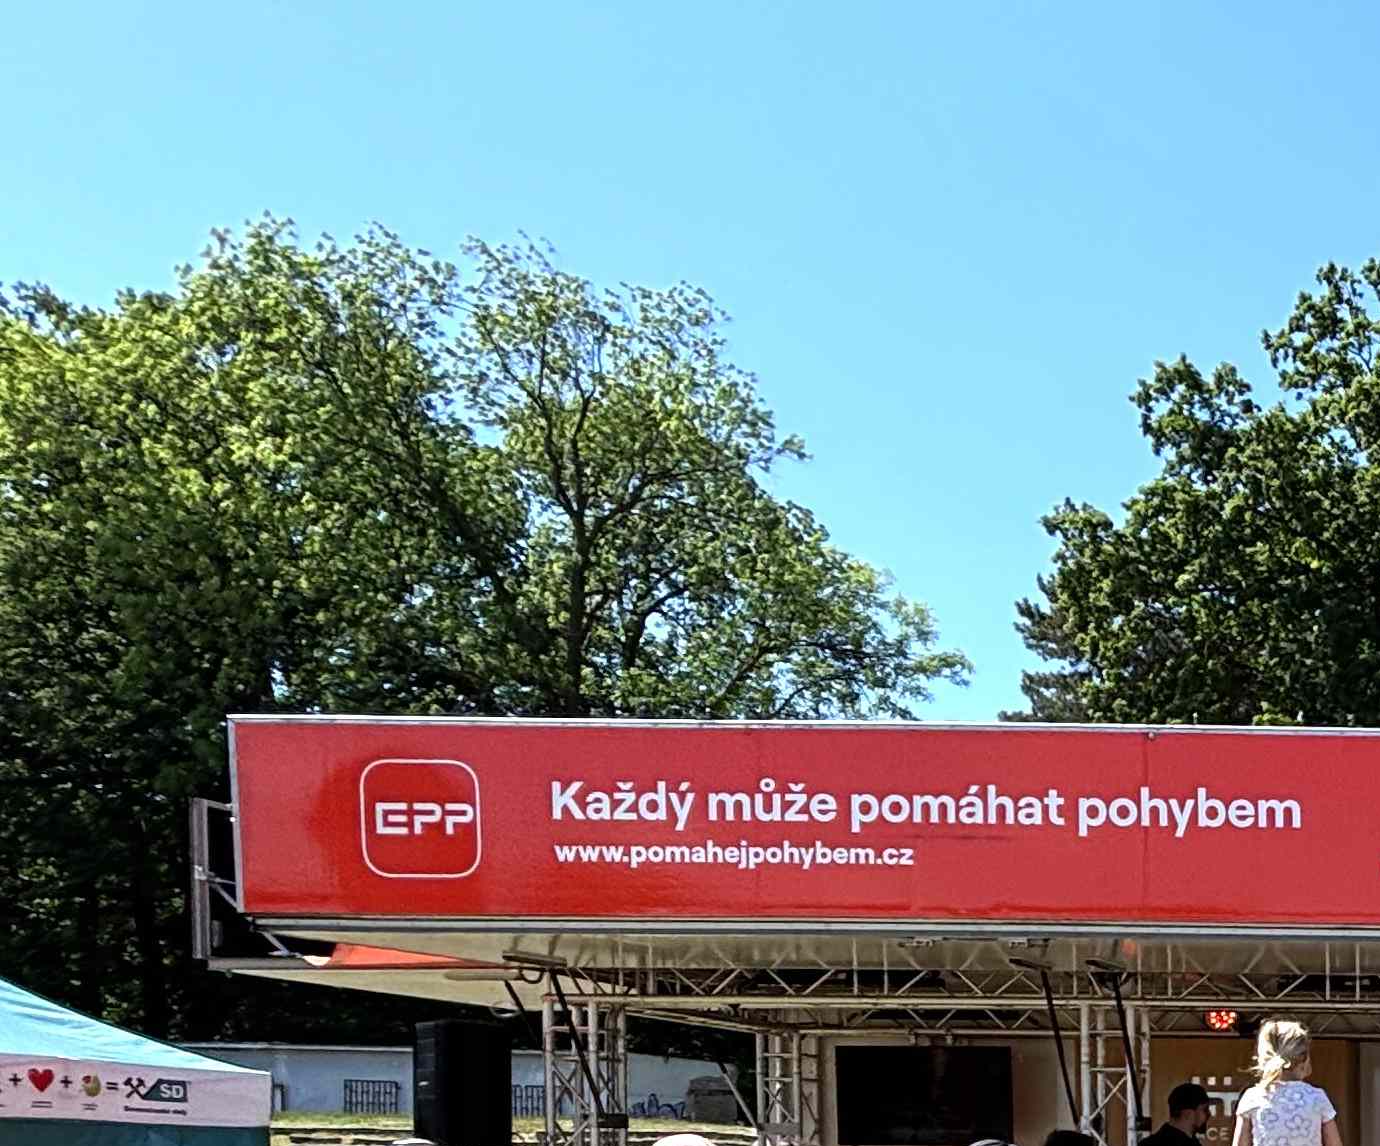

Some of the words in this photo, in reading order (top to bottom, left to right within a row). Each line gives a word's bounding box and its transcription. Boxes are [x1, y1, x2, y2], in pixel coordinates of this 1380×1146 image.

[375, 802, 474, 835] EPP
[551, 780, 694, 831] Každý
[708, 777, 838, 822] může
[850, 784, 1065, 833] pomáhat
[1078, 786, 1302, 838] pohybem
[554, 839, 914, 870] www.pomahejpohybem.cz
[159, 1083, 185, 1099] SD
